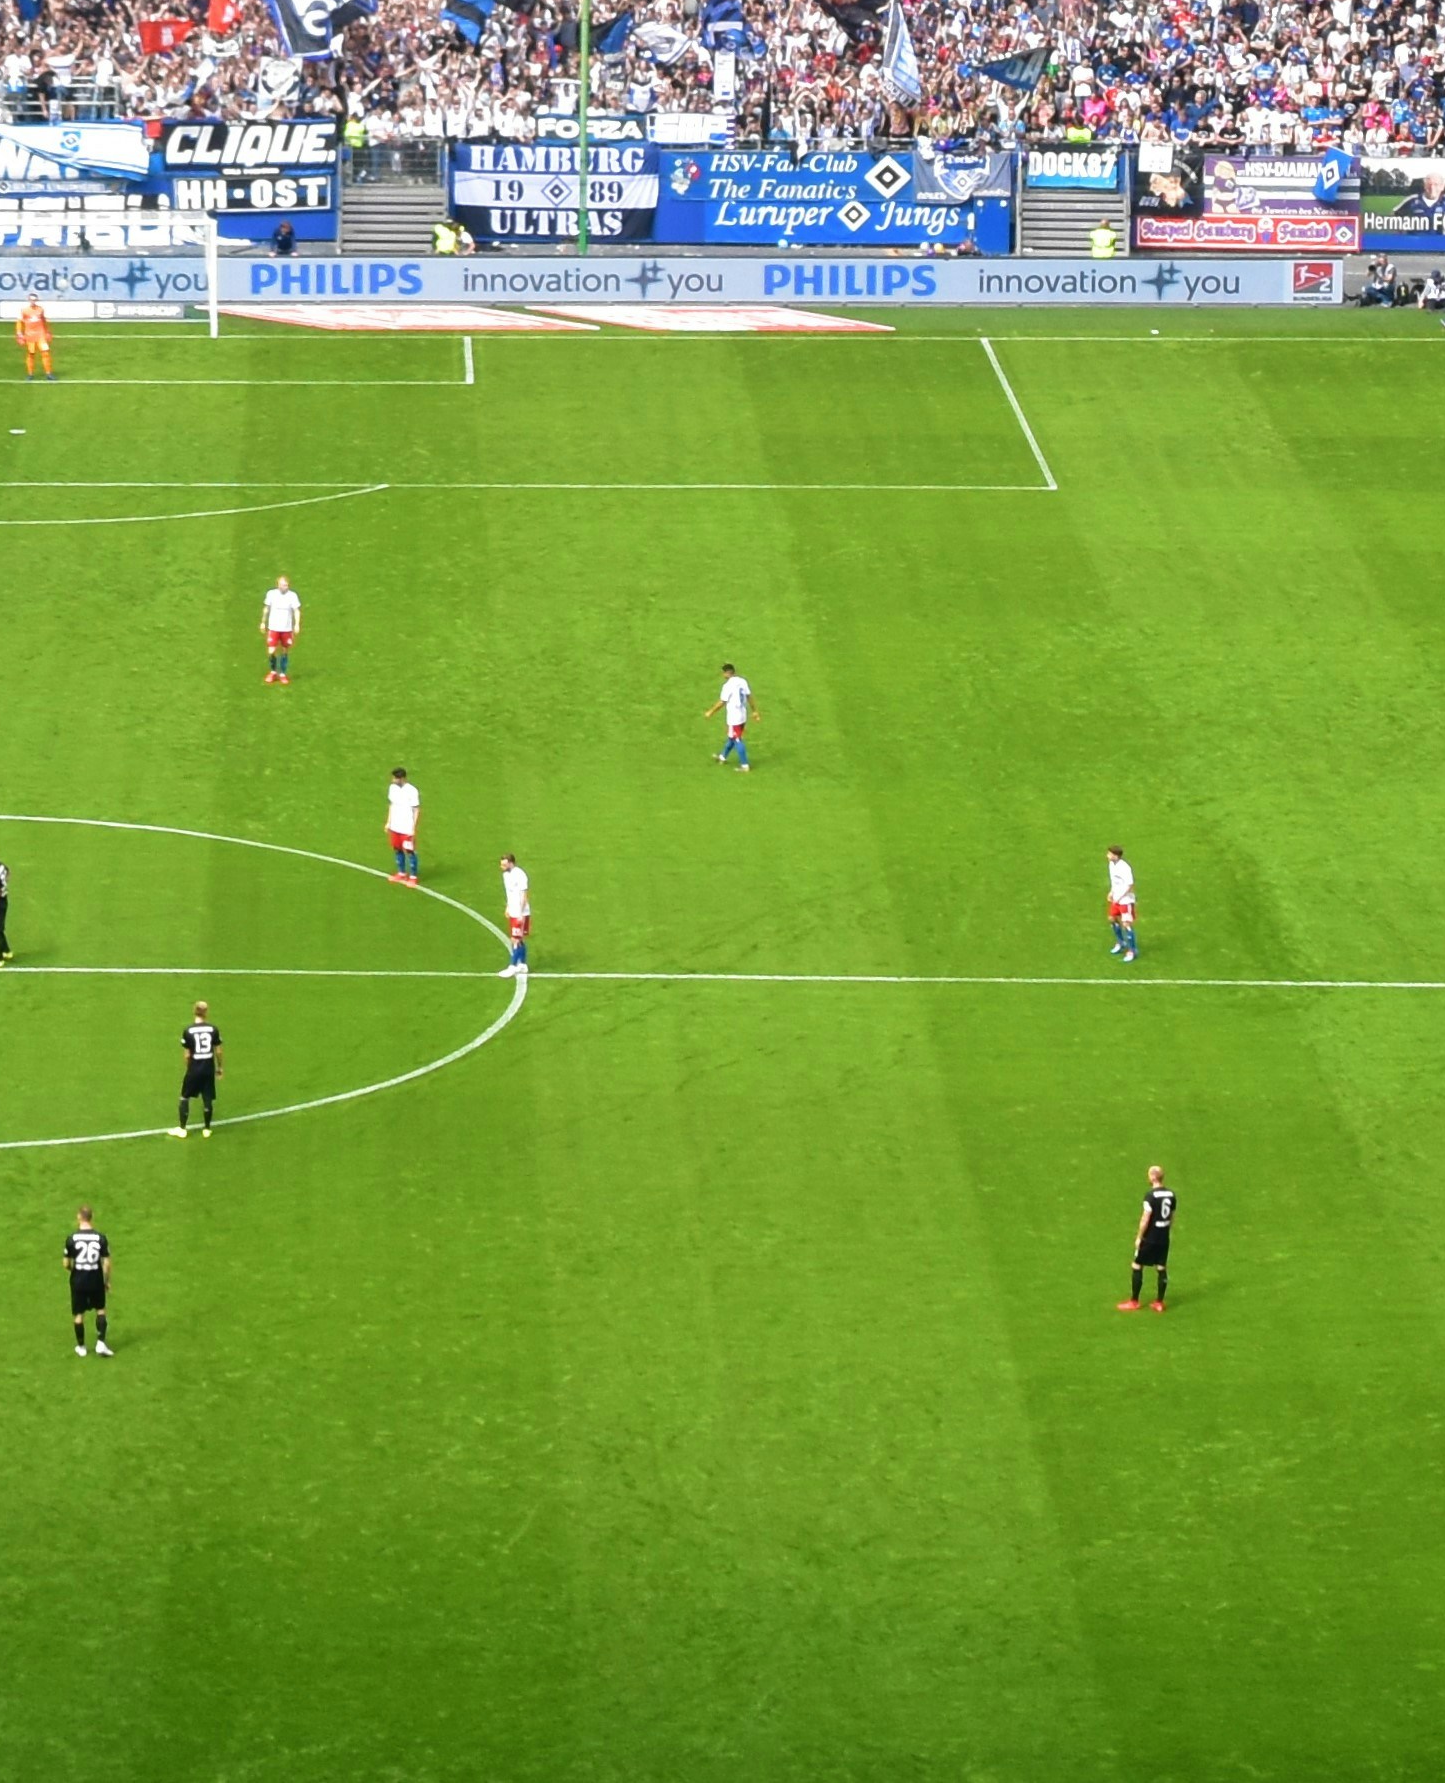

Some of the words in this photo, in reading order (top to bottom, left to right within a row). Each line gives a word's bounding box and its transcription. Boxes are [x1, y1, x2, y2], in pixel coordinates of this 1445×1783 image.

[469, 145, 644, 172] HAMBURG
[491, 179, 524, 202] 19
[588, 179, 624, 204] 89
[711, 180, 753, 199] The
[760, 179, 858, 200] Fanatics
[489, 208, 624, 236] ULTRAS
[715, 201, 834, 235] Luruper
[874, 202, 960, 233] Jungs
[1363, 211, 1430, 233] Hermann
[250, 263, 424, 295] PHILIPS
[463, 267, 621, 293] innovation
[666, 271, 725, 300] you
[763, 264, 938, 296] PHILIPS
[978, 268, 1138, 294] innovation
[1184, 272, 1241, 301] you
[75, 1241, 102, 1264] 26
